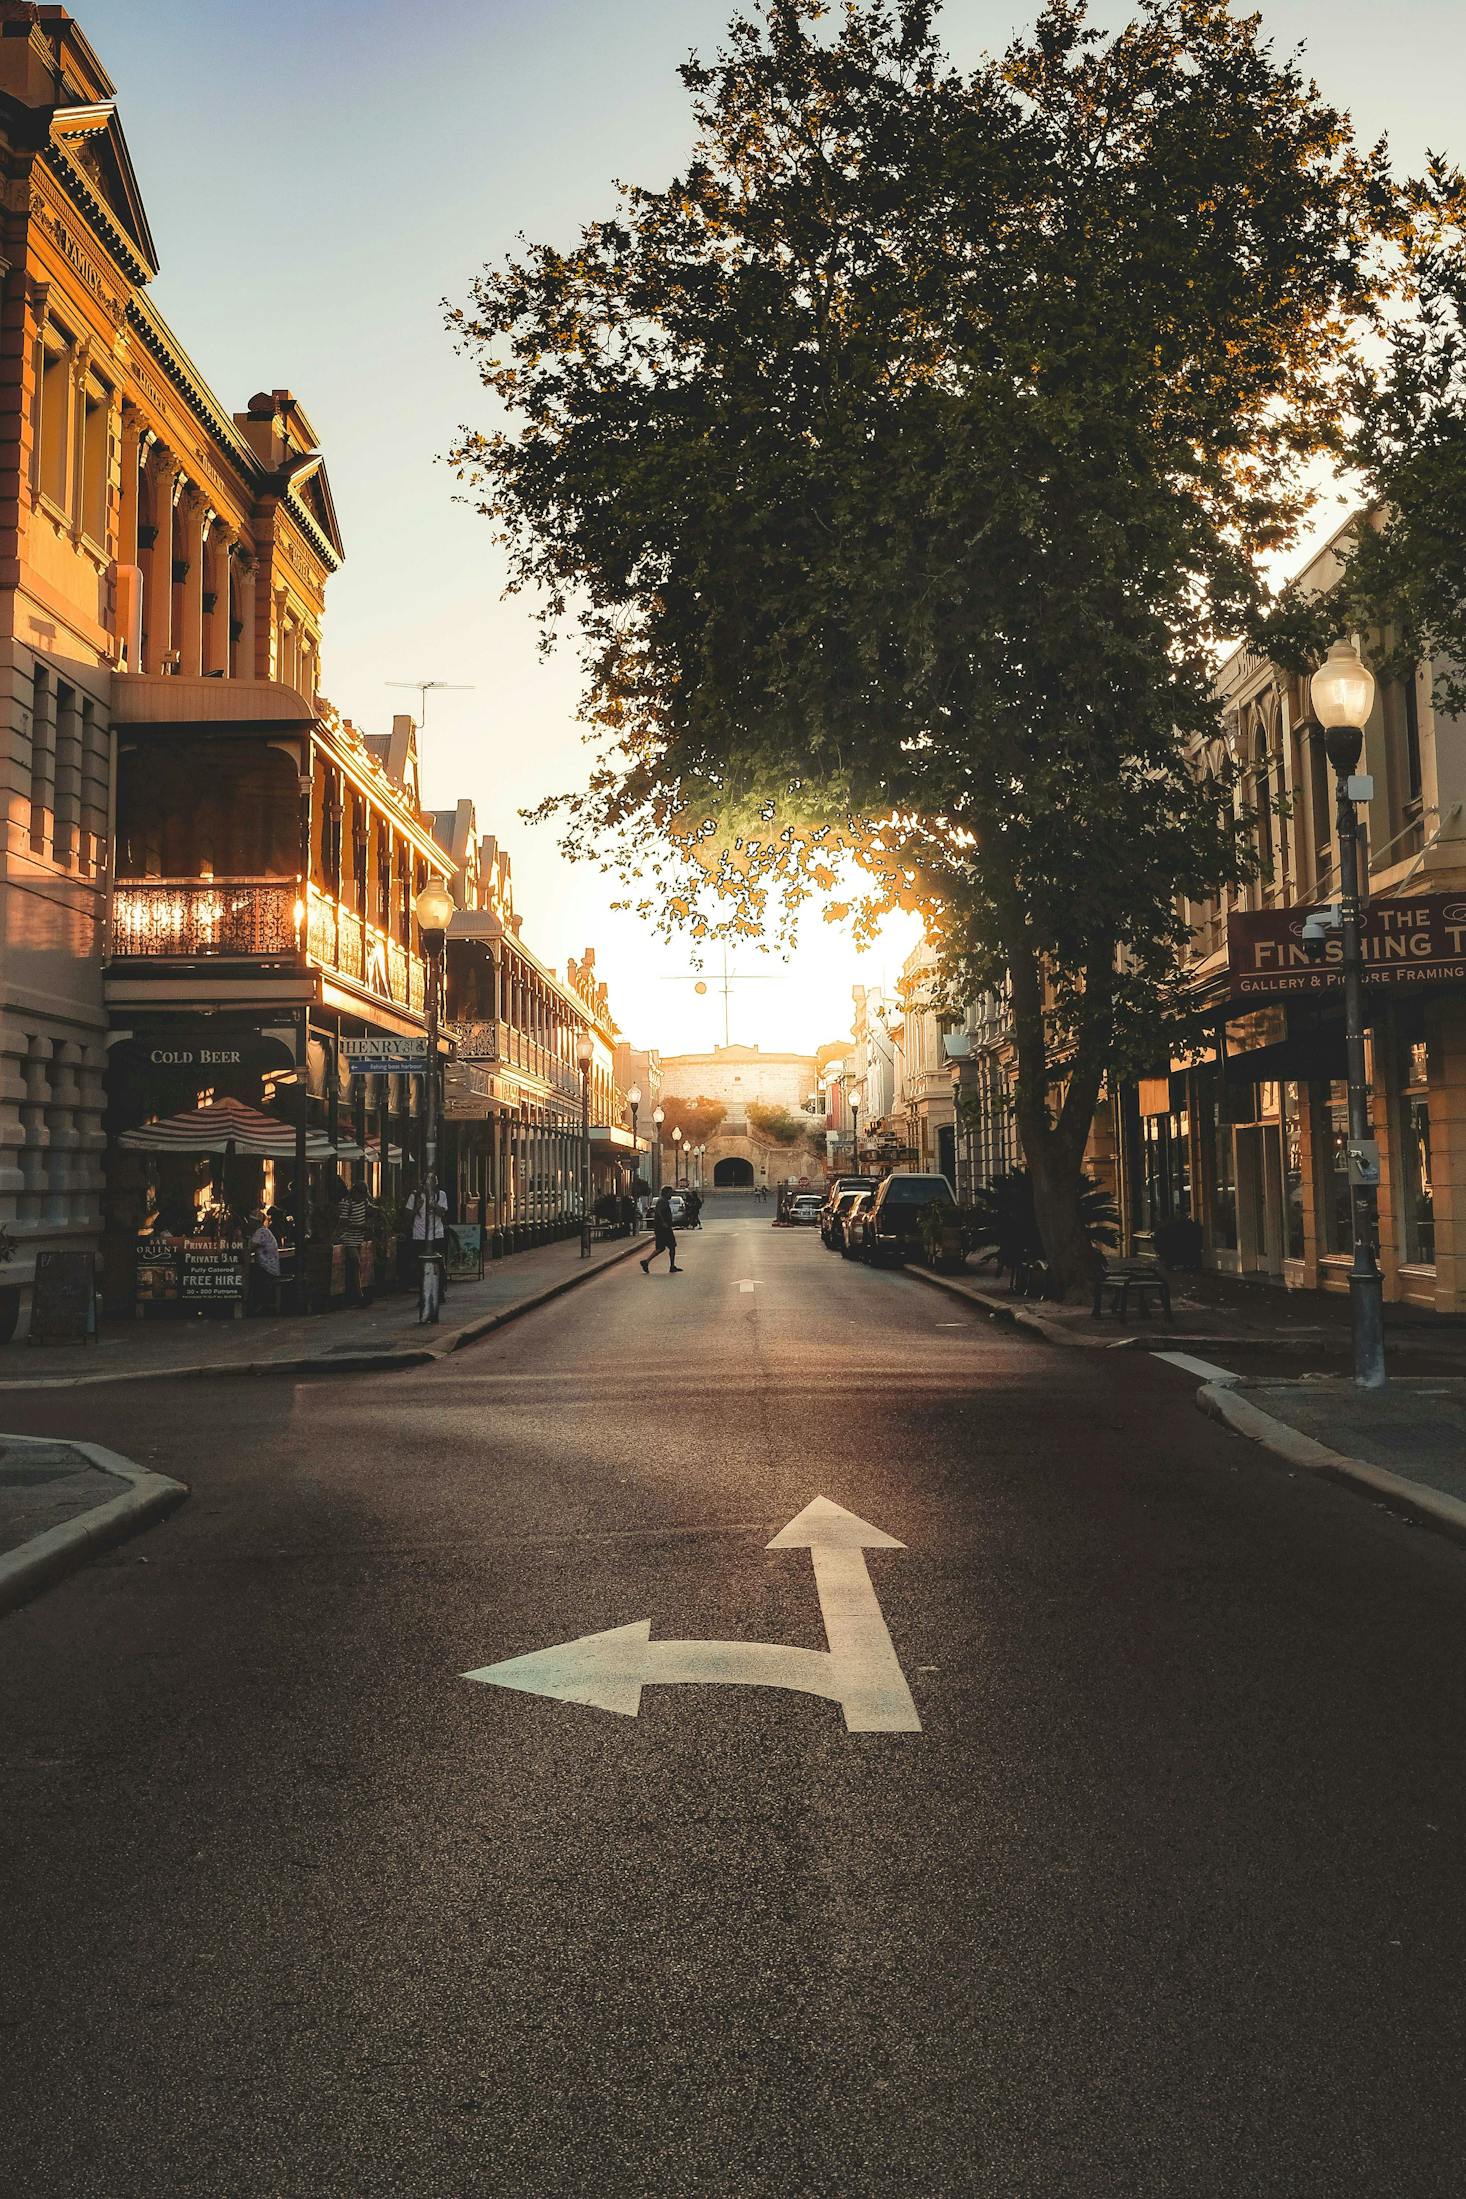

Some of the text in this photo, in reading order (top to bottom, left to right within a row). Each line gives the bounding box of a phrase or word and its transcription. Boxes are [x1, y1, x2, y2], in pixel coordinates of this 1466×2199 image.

[1377, 908, 1431, 931] THE
[1254, 932, 1432, 968] FINSING
[1240, 966, 1465, 992] GALLERY & PIURE FRAMING
[346, 1040, 401, 1054] HENRY
[151, 1049, 241, 1064] COLD BEER
[136, 1246, 178, 1255] ORIENT
[182, 1275, 243, 1286] FREE HIRE
